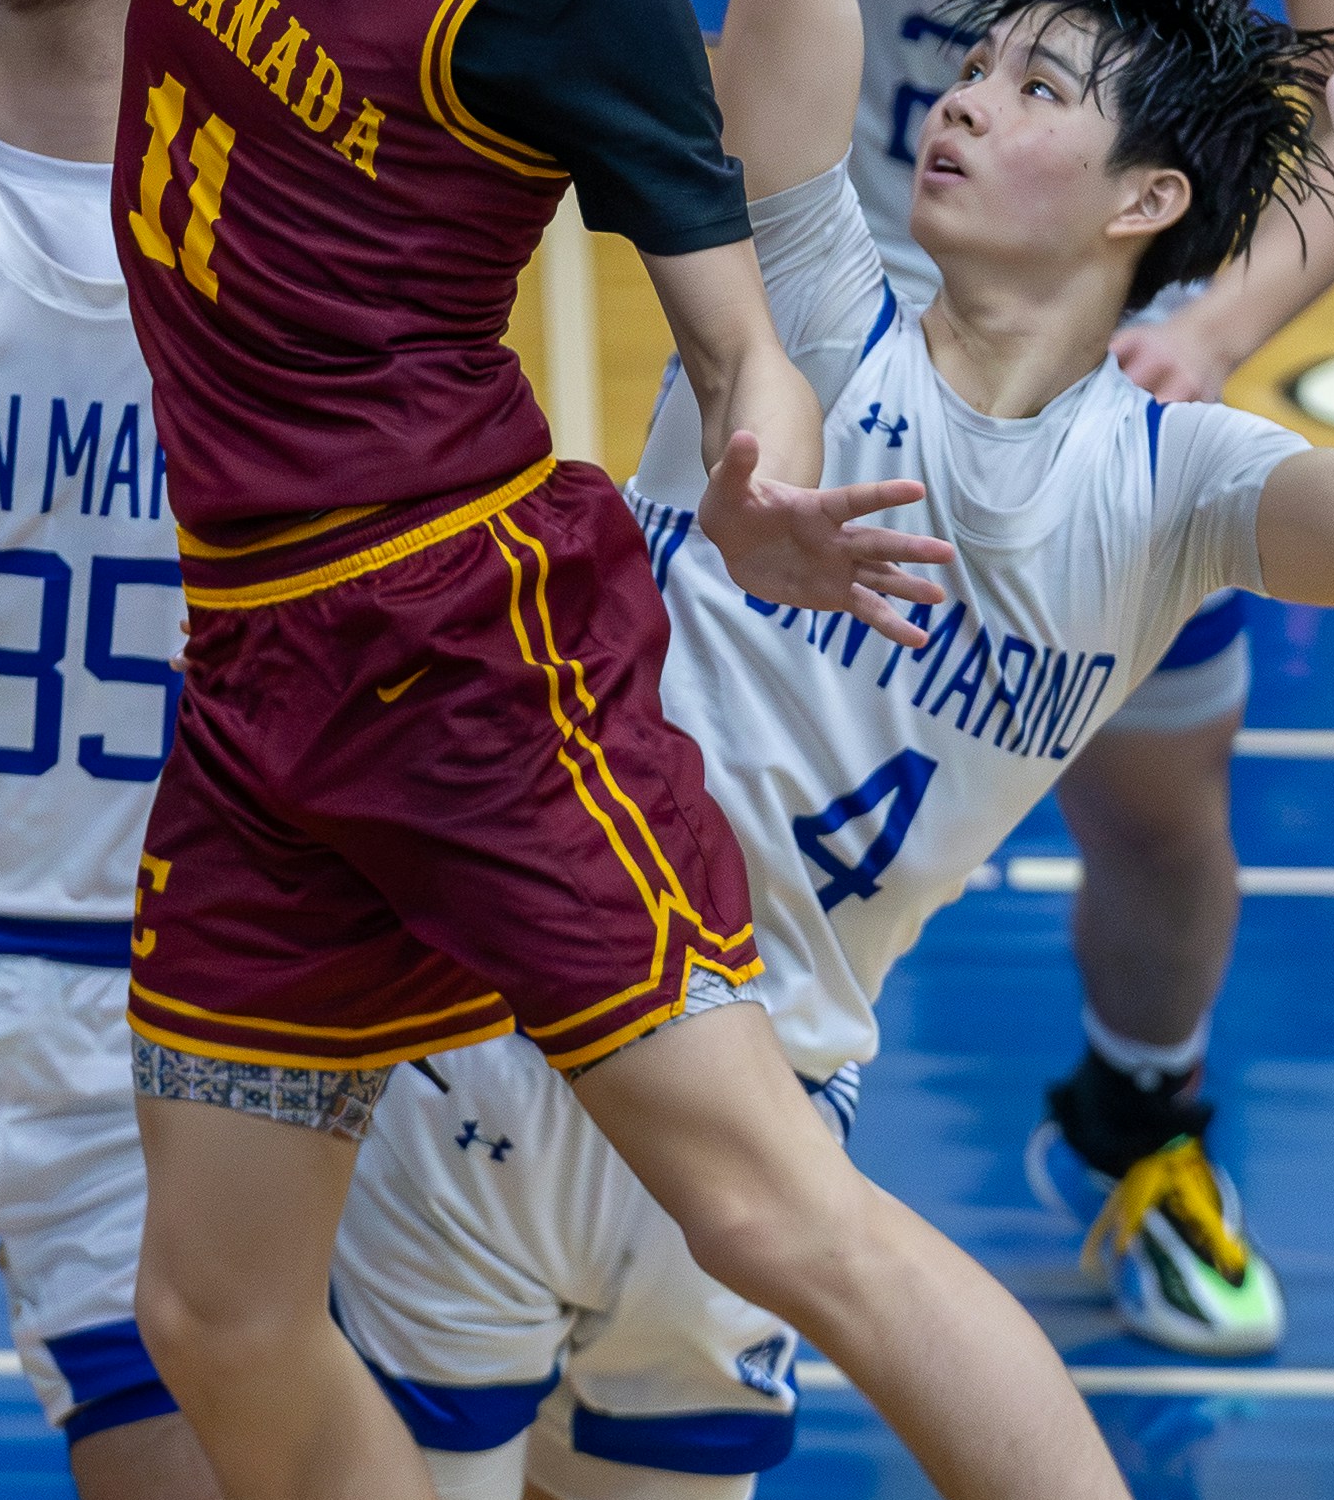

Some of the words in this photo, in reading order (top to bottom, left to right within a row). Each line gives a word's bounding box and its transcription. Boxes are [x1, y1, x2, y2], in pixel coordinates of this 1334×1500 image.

[128, 71, 237, 304] 11
[877, 600, 1116, 761] MARINO
[793, 747, 939, 913] 4
